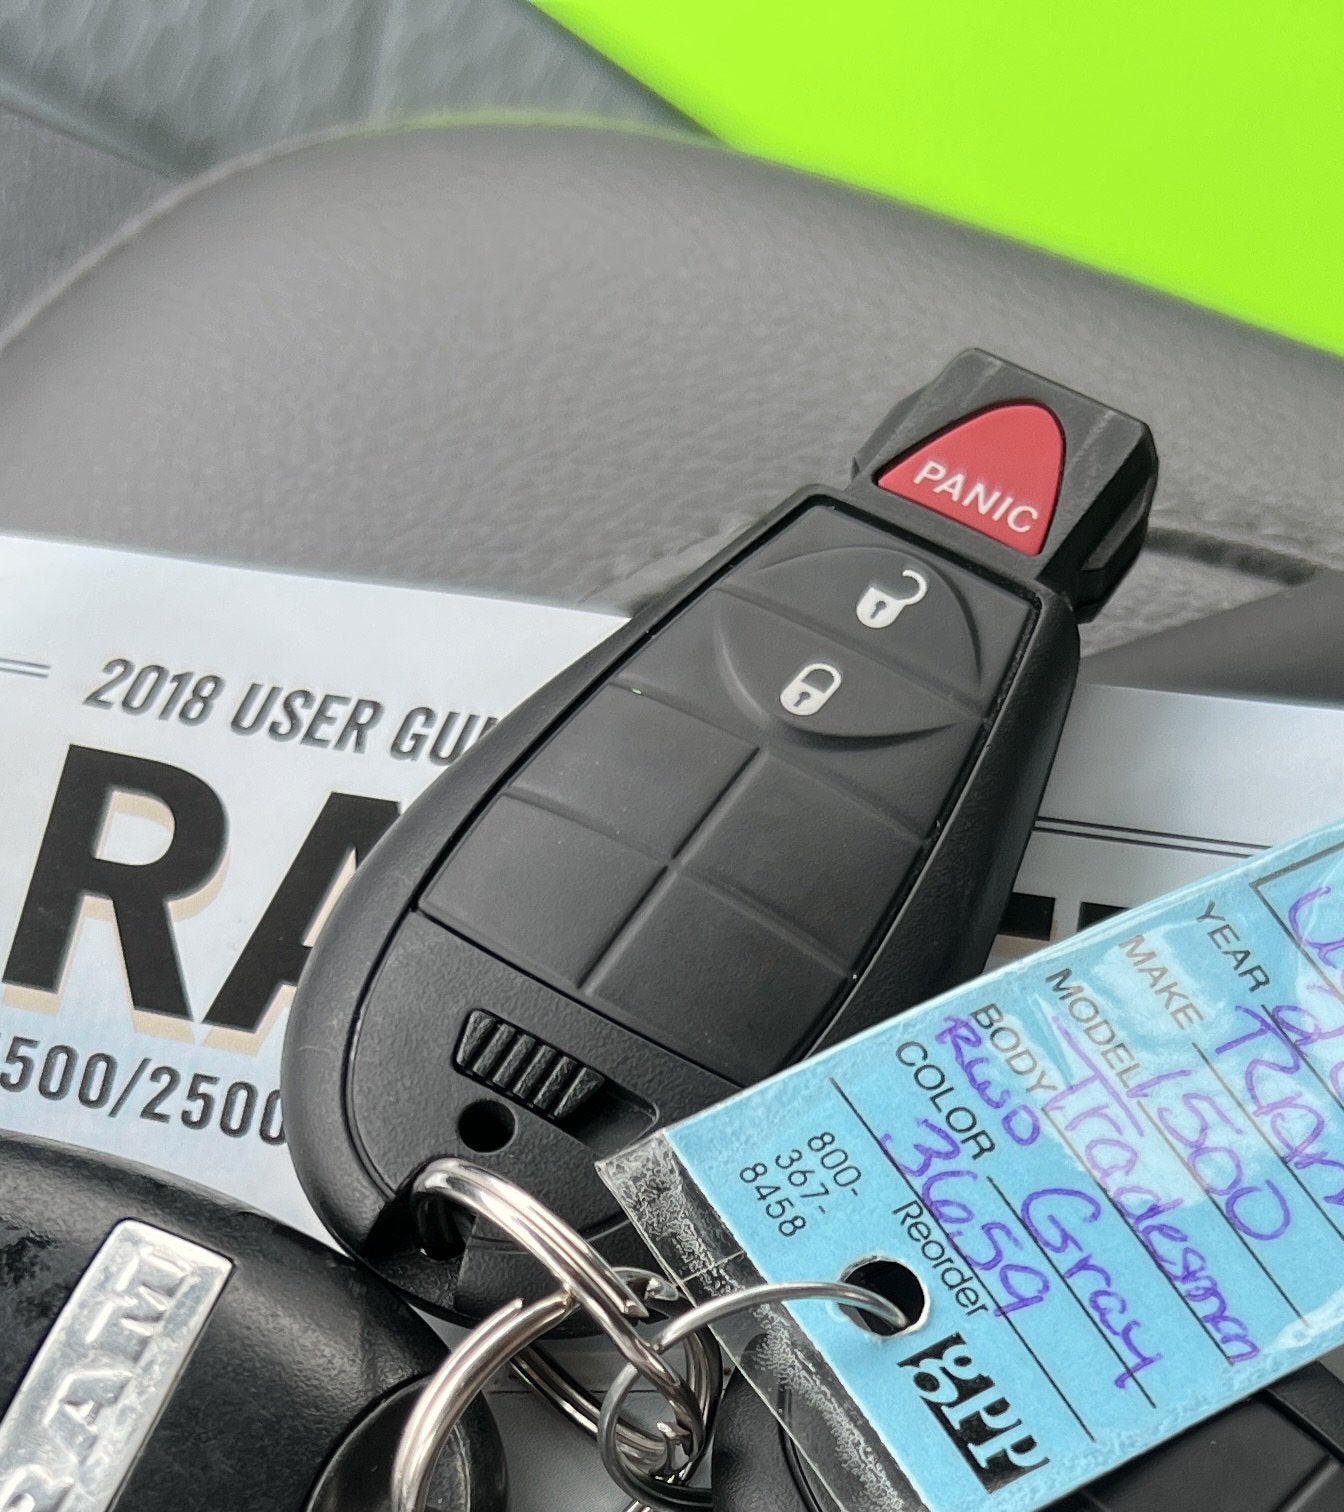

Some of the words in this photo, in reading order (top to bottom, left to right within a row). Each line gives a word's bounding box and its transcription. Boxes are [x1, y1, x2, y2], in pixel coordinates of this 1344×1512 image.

[913, 461, 1039, 534] PANIC
[82, 658, 225, 727] 2018
[230, 681, 383, 754] USER
[1119, 934, 1204, 1030] MAKE
[1197, 901, 1270, 993] YEAR
[970, 1003, 1056, 1094] BODY
[1045, 968, 1144, 1088] MODEL
[896, 1040, 996, 1161] COLOR
[935, 1014, 1041, 1147] RWD
[739, 1162, 807, 1237] 8458
[775, 1149, 831, 1214] 367-
[807, 1131, 862, 1197] 800-
[1126, 1067, 1292, 1241] 1500
[879, 1116, 1050, 1318] 3659
[892, 1200, 989, 1318] Reorder
[1020, 1186, 1163, 1389] Gray
